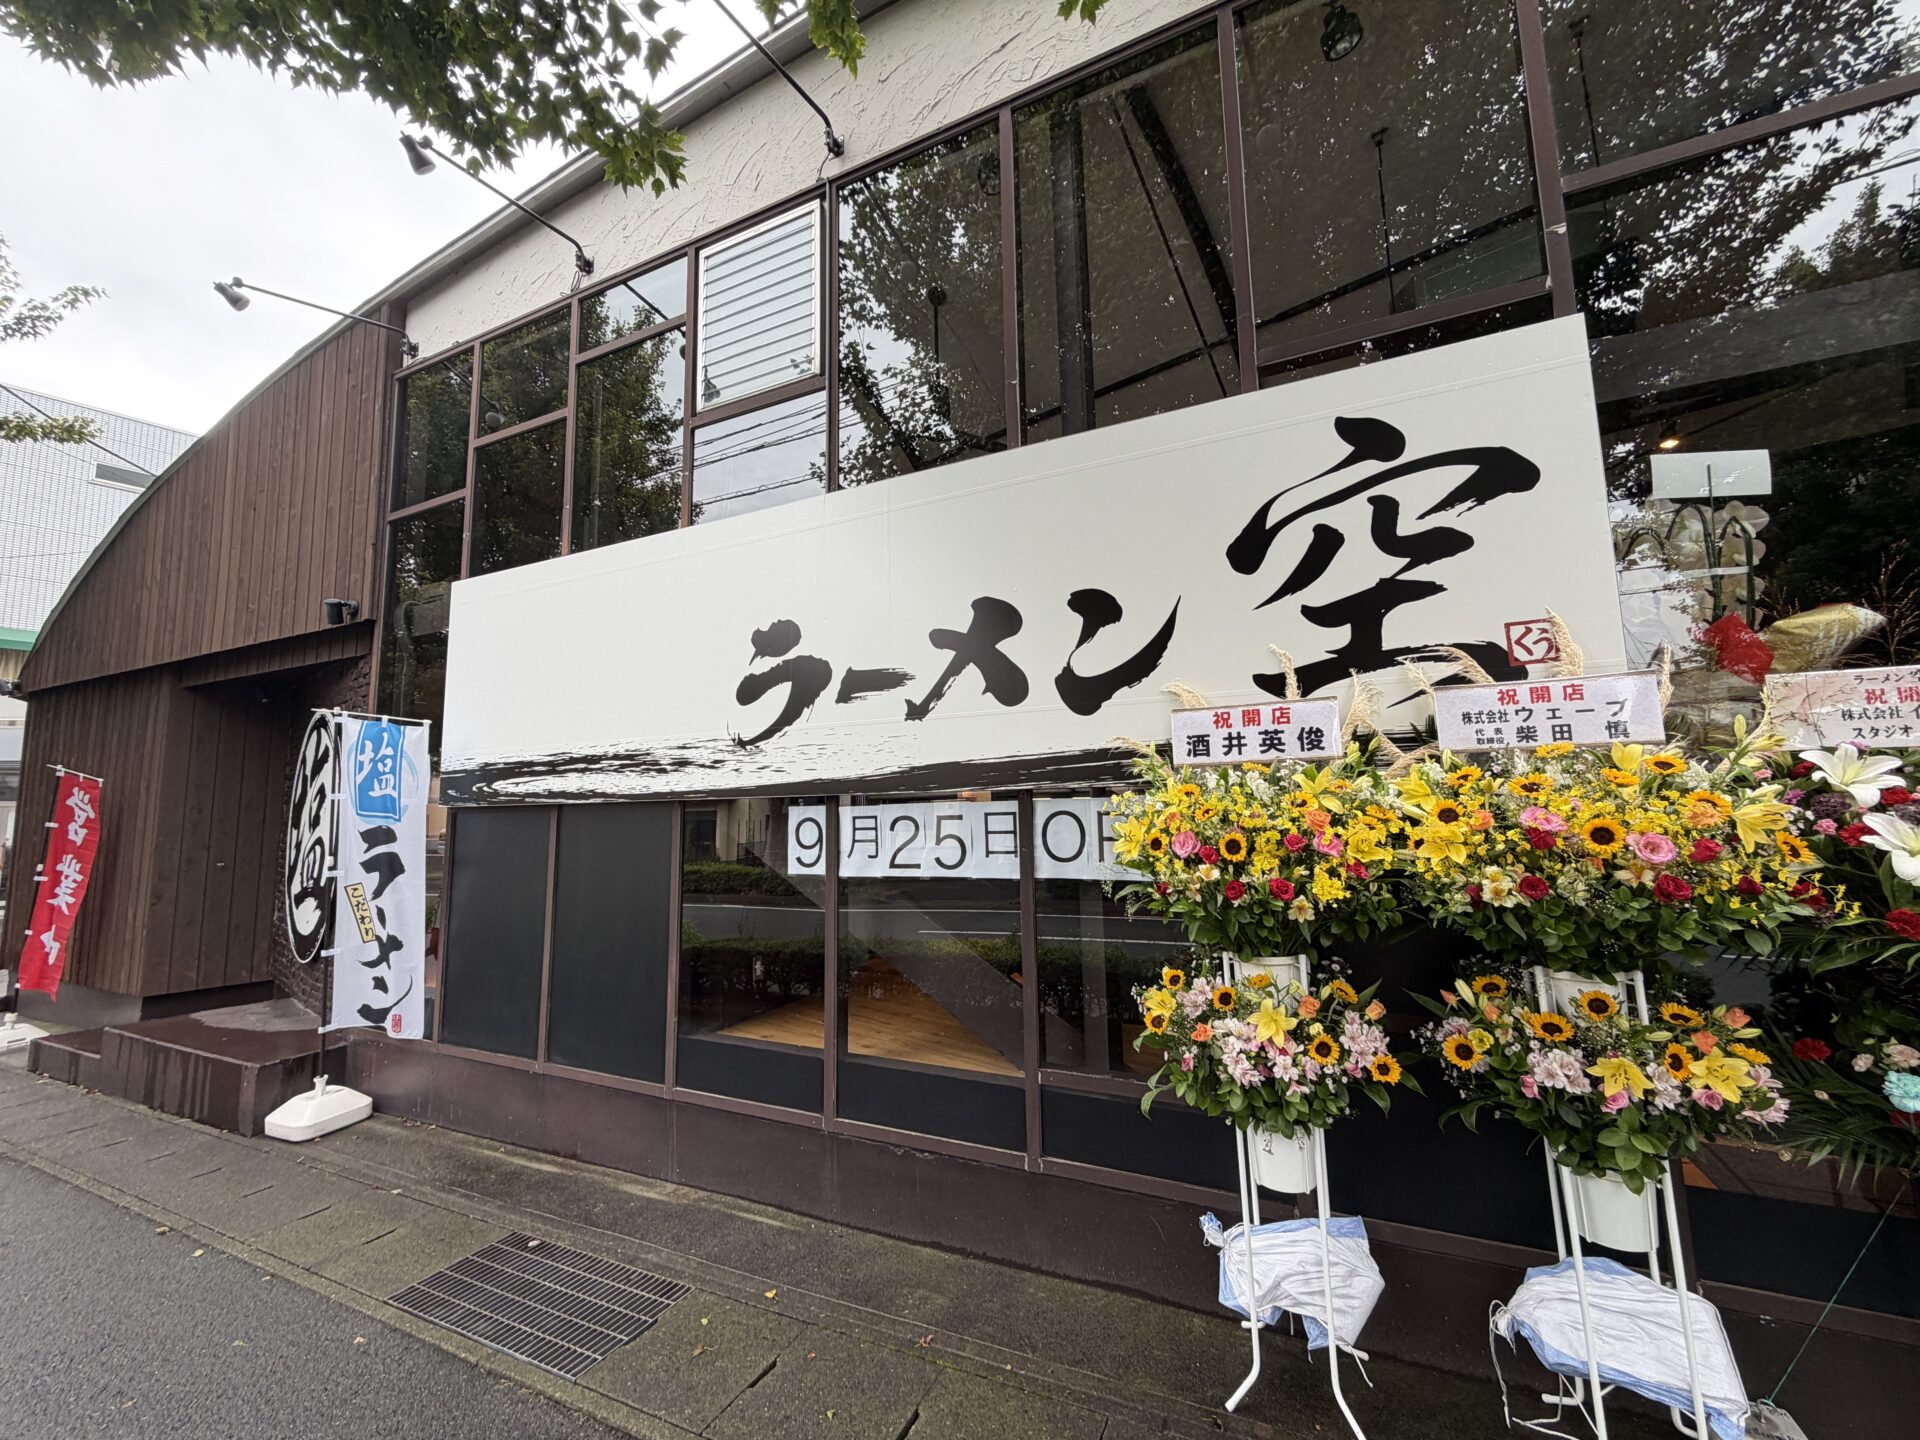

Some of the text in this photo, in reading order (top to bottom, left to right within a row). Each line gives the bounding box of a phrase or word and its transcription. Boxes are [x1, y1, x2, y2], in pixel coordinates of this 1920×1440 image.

[726, 416, 1541, 749] ラーメン 空
[1514, 625, 1555, 659] くう
[1496, 683, 1585, 706] 祝開店
[1212, 706, 1291, 730] 祝開店
[1851, 724, 1914, 740] スタジオ
[1185, 726, 1326, 758] 酒井英俊
[355, 731, 398, 799] 塩
[350, 886, 376, 940] こだわり
